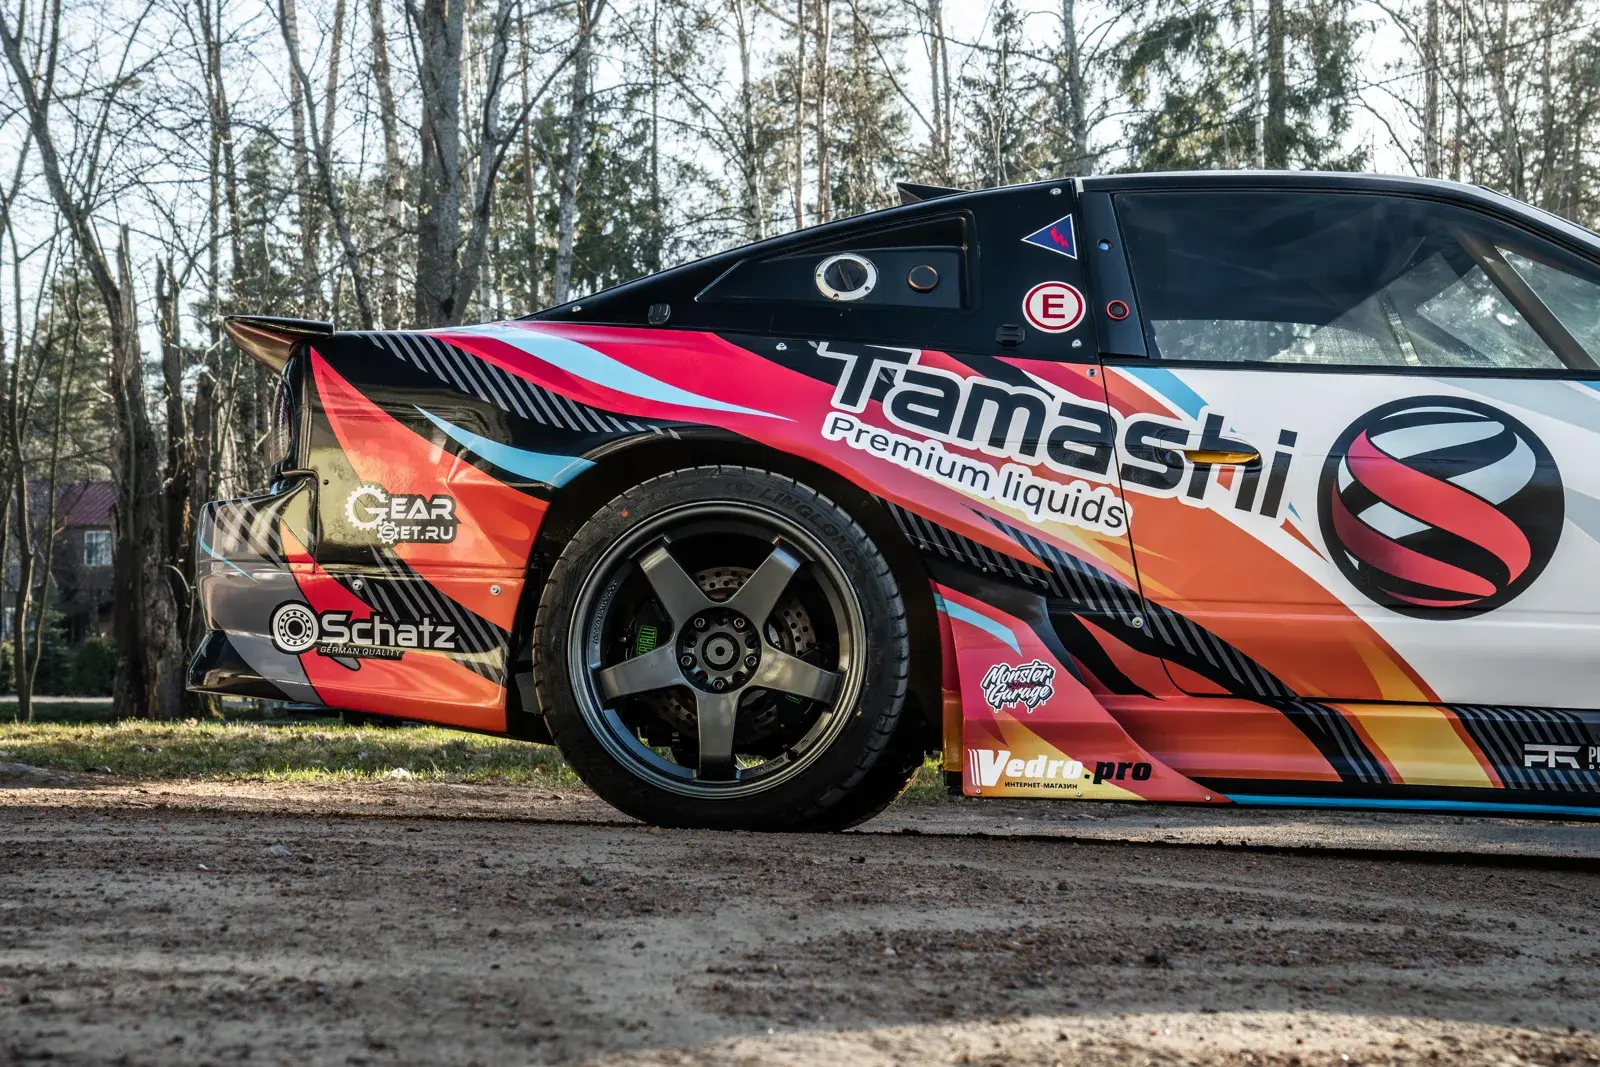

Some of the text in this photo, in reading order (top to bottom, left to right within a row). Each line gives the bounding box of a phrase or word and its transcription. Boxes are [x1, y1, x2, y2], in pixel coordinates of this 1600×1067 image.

[1042, 294, 1066, 319] E
[820, 342, 1298, 519] Tamashi
[830, 417, 1125, 529] Premium liquids
[345, 484, 453, 531] GEAR
[377, 520, 453, 545] SET.RU
[758, 487, 861, 566] LINGLONG
[321, 613, 455, 649] Schatz
[638, 626, 656, 656] RIALLI
[320, 645, 402, 658] GERMAN QUALITY
[982, 661, 1053, 688] Monster
[988, 683, 1052, 707] Garage
[968, 749, 1153, 787] Vedro.pro
[1004, 781, 1078, 790] ИНТЕРНЕТ-МАГАЗИН
